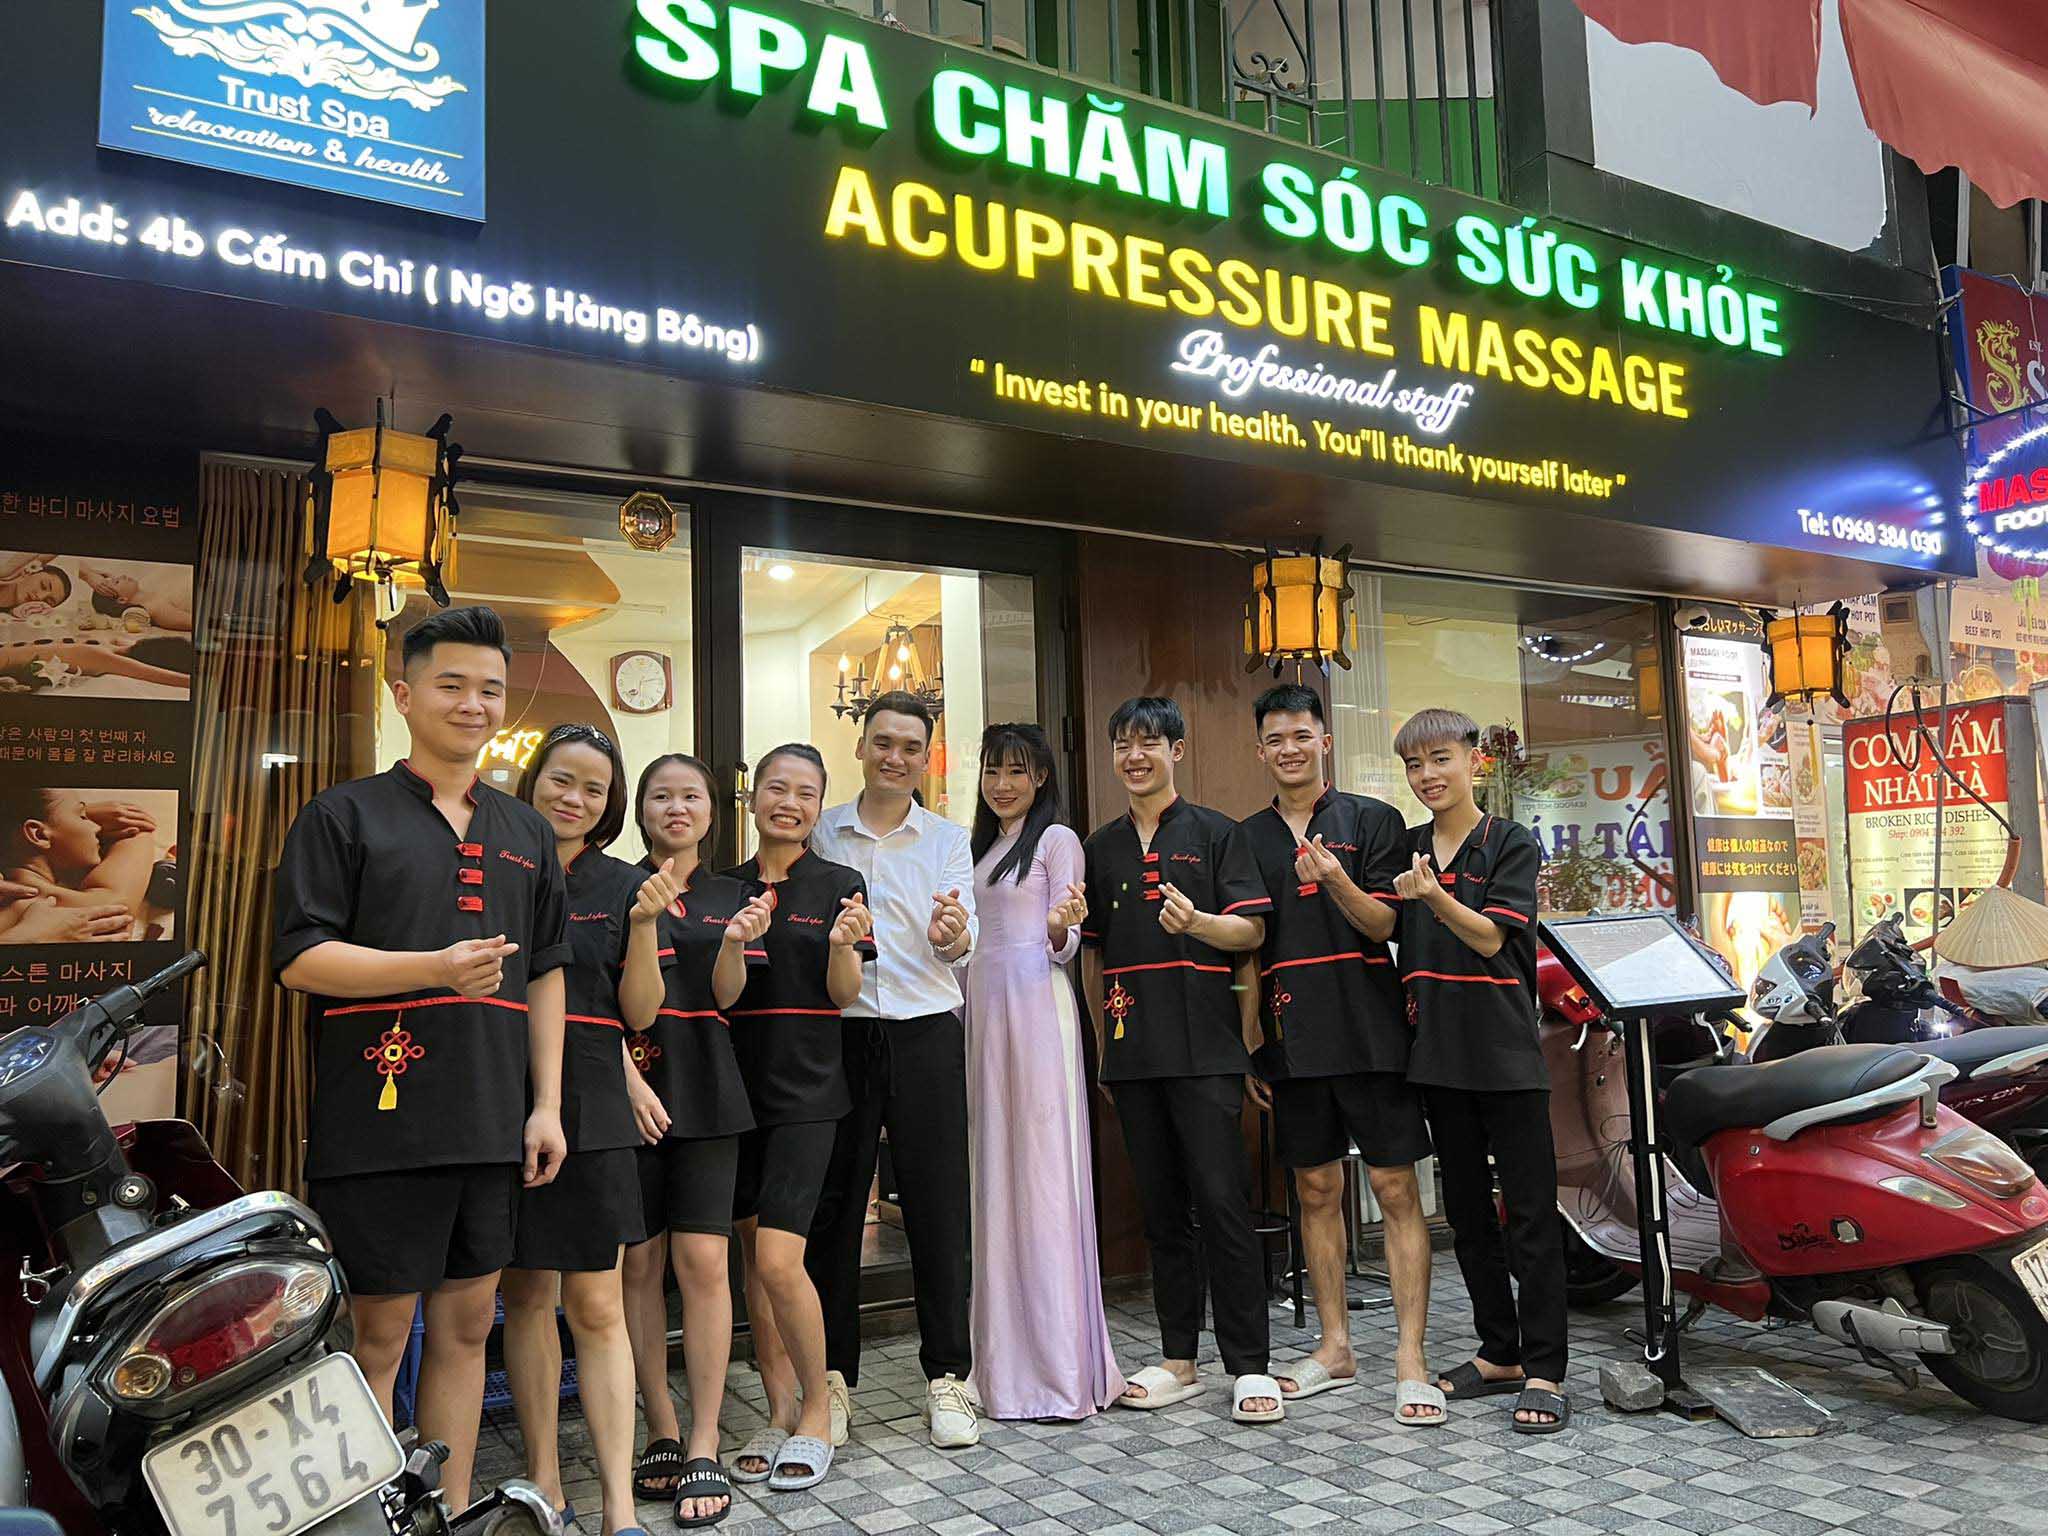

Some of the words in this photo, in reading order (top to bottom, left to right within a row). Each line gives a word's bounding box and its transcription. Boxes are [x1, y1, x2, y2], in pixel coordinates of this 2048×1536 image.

[218, 74, 311, 122] Trust
[321, 99, 390, 138] Spa
[148, 107, 316, 157] relaxation
[323, 139, 347, 163] &
[354, 147, 449, 184] health
[635, 0, 888, 130] SPA
[932, 70, 1230, 217] CHĂM
[1261, 162, 1430, 267] SÓC
[1455, 215, 1599, 309] SỨC
[1620, 257, 1784, 357] KHỎE
[7, 191, 129, 245] Add:
[140, 217, 204, 256] 4b
[216, 228, 326, 280] Cấm
[545, 287, 646, 343] Hàng
[824, 165, 1395, 356] ACUPRESSURE
[1419, 305, 1690, 419] MASSAGE
[1171, 329, 1397, 397] Professional
[1393, 382, 1474, 434] staff
[995, 362, 1092, 411] Invest
[1099, 382, 1128, 418] in
[1136, 396, 1203, 428] your
[1209, 401, 1307, 448] health.
[1392, 435, 1465, 473] thank
[1468, 454, 1558, 490] yourself
[1563, 463, 1613, 498] later
[28, 495, 68, 521] 바디
[76, 499, 135, 526] 마사지
[141, 504, 182, 528] 요법
[1797, 509, 1830, 536] Tel:
[1832, 515, 1876, 544] 0968
[1979, 466, 2048, 513] MAS
[28, 727, 73, 743] 사람의
[1865, 814, 1911, 828] BROKEN
[1914, 812, 1937, 825] RIC
[1945, 808, 1990, 823] DISHES
[60, 959, 132, 983] 마사지
[180, 1376, 341, 1496] 30-X4
[205, 1432, 370, 1536] 7564
